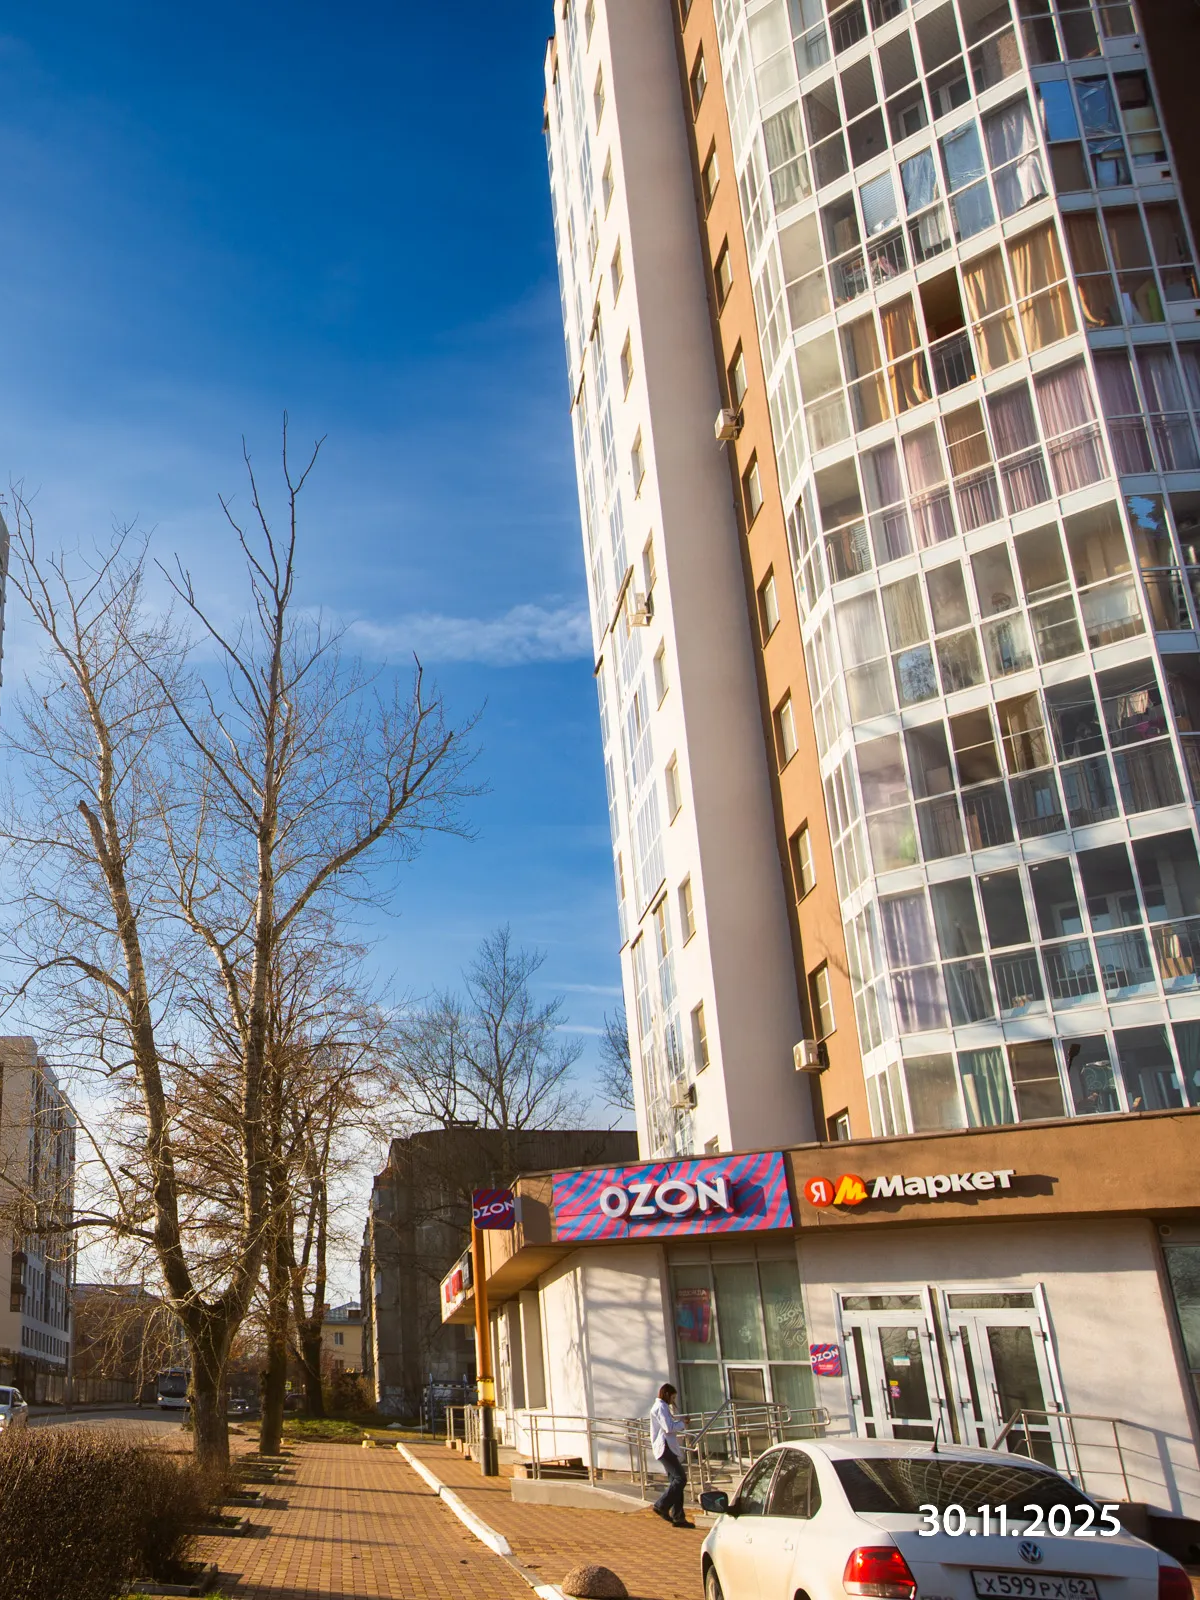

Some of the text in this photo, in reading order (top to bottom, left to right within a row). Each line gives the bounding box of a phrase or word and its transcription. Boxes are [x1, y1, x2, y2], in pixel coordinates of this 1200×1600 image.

[600, 1174, 732, 1218] OZON
[810, 1181, 827, 1203] Я
[872, 1169, 1016, 1198] Маркет
[473, 1201, 515, 1219] OZON
[810, 1349, 838, 1363] OZON
